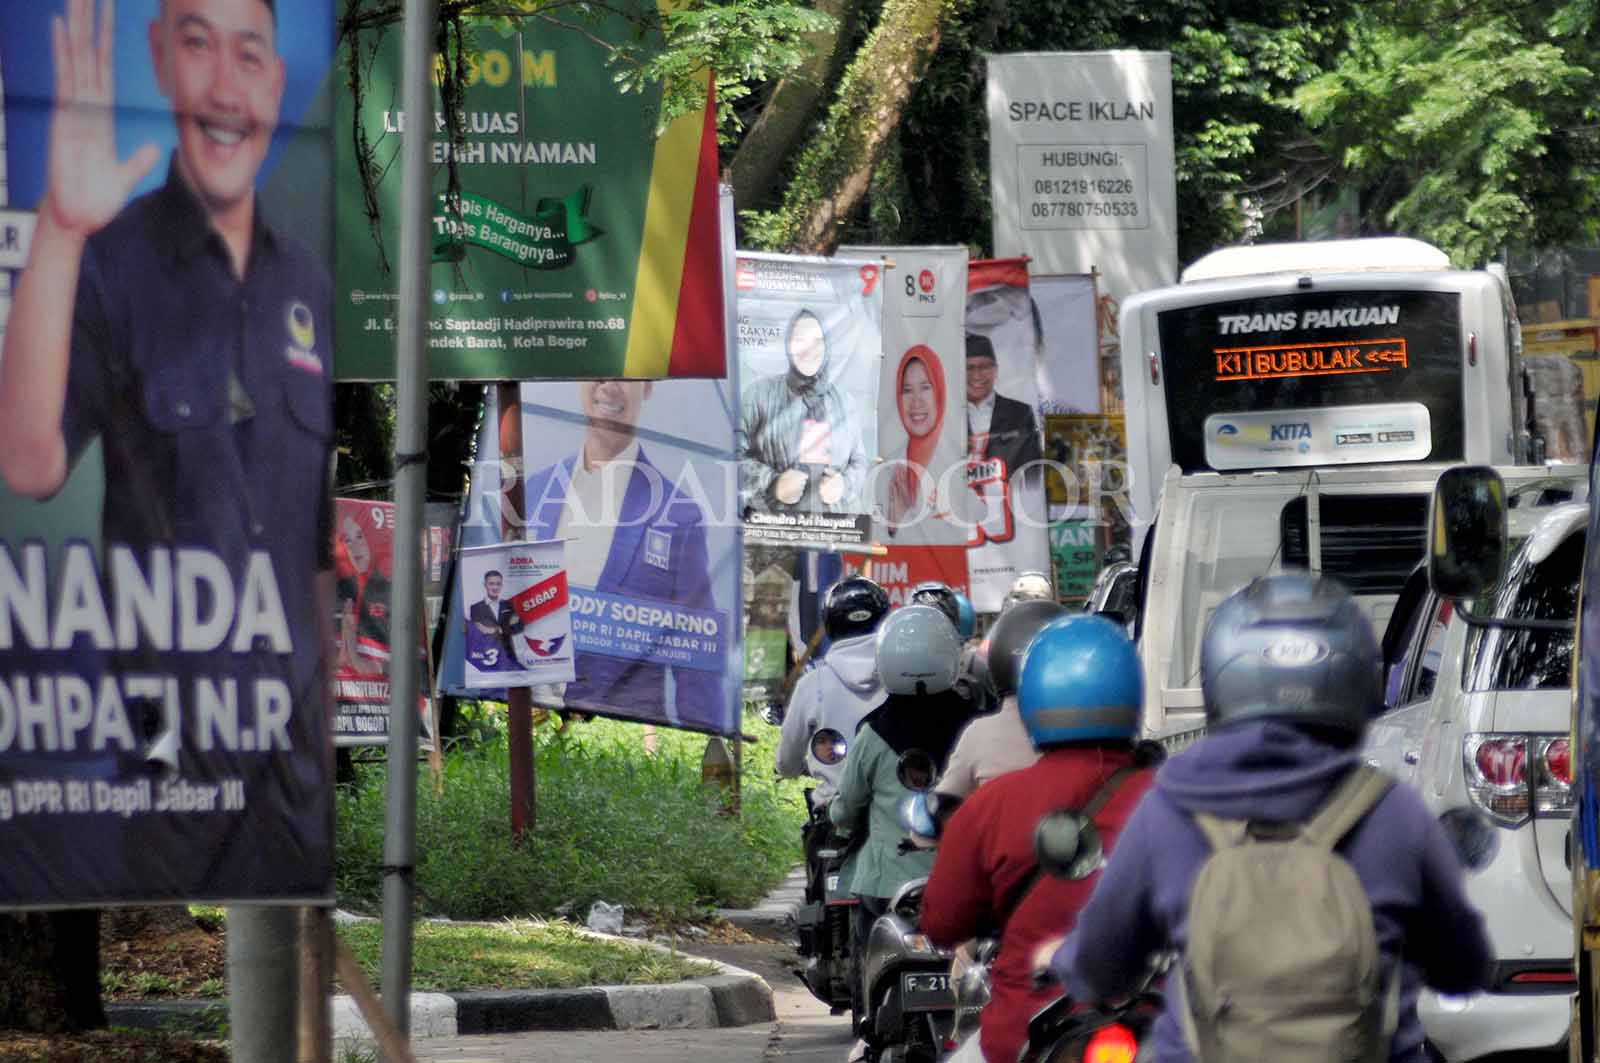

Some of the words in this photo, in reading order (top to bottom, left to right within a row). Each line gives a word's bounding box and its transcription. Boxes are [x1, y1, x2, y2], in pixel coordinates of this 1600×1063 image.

[1009, 101, 1082, 121] SPACE
[1089, 101, 1154, 121] IKLAN
[491, 142, 596, 163] NYAMAN
[1042, 151, 1124, 167] HUBUNGI:
[486, 204, 565, 242] Harganya...
[480, 224, 567, 263] Barangnya...
[859, 263, 880, 297] 9
[905, 274, 916, 298] 8
[445, 318, 501, 333] Saptadji
[505, 317, 585, 333] Hadiprawira
[588, 318, 626, 332] no.68
[1219, 311, 1296, 335] TRANS
[1302, 305, 1400, 329] PAKUAN
[430, 336, 464, 348] ndek
[514, 336, 545, 348] Kota
[548, 336, 588, 350] Bogor
[1217, 354, 1242, 376] K1
[1255, 350, 1362, 375] BUBULAK
[1271, 422, 1312, 441] KITA
[371, 507, 386, 529] 9
[0, 544, 293, 653] NANDA
[611, 602, 719, 637] SOEPARNO
[573, 619, 598, 633] DPR
[600, 624, 612, 637] RI
[616, 626, 653, 644] DAPIL
[656, 633, 699, 653] JABAR
[195, 676, 292, 752] N.R
[17, 779, 64, 814] DPR
[65, 779, 90, 813] RI
[94, 778, 151, 818] Dapil
[908, 977, 918, 992] F
